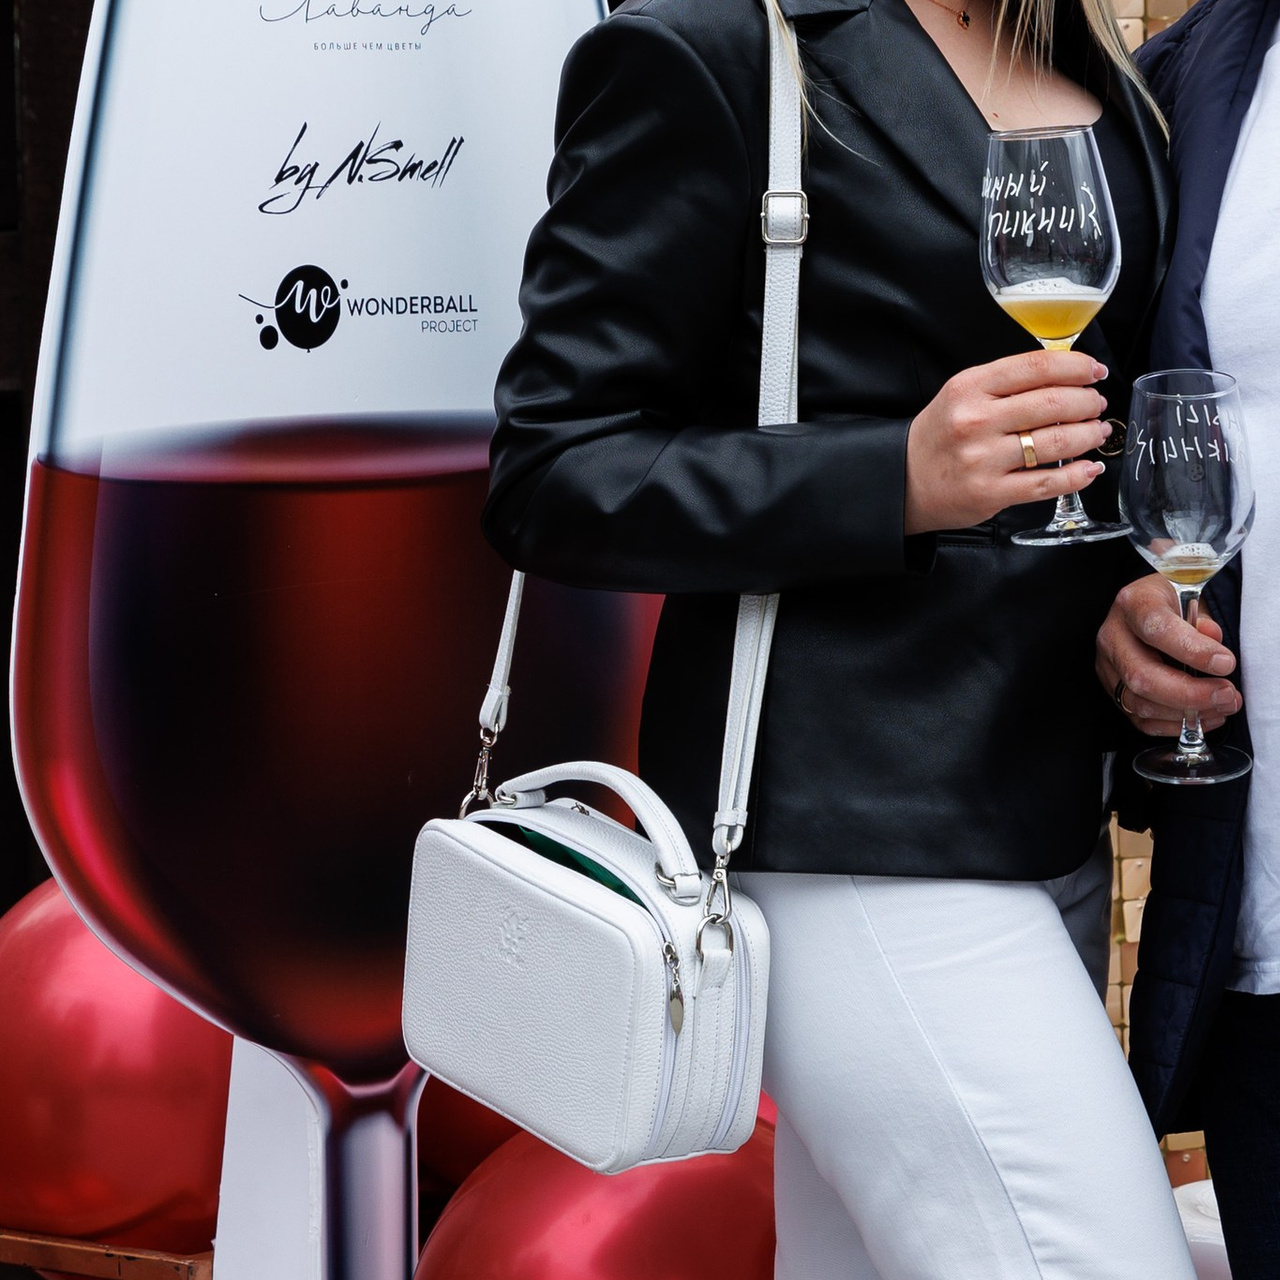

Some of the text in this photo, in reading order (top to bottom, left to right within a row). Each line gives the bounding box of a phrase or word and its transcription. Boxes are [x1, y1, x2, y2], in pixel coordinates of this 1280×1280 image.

[313, 41, 422, 51] БОЛЬШЕ ЧЕМ ЦВЕТЫ
[258, 121, 321, 215] by
[347, 294, 478, 317] WONDERBALL
[421, 319, 479, 333] PROJECT
